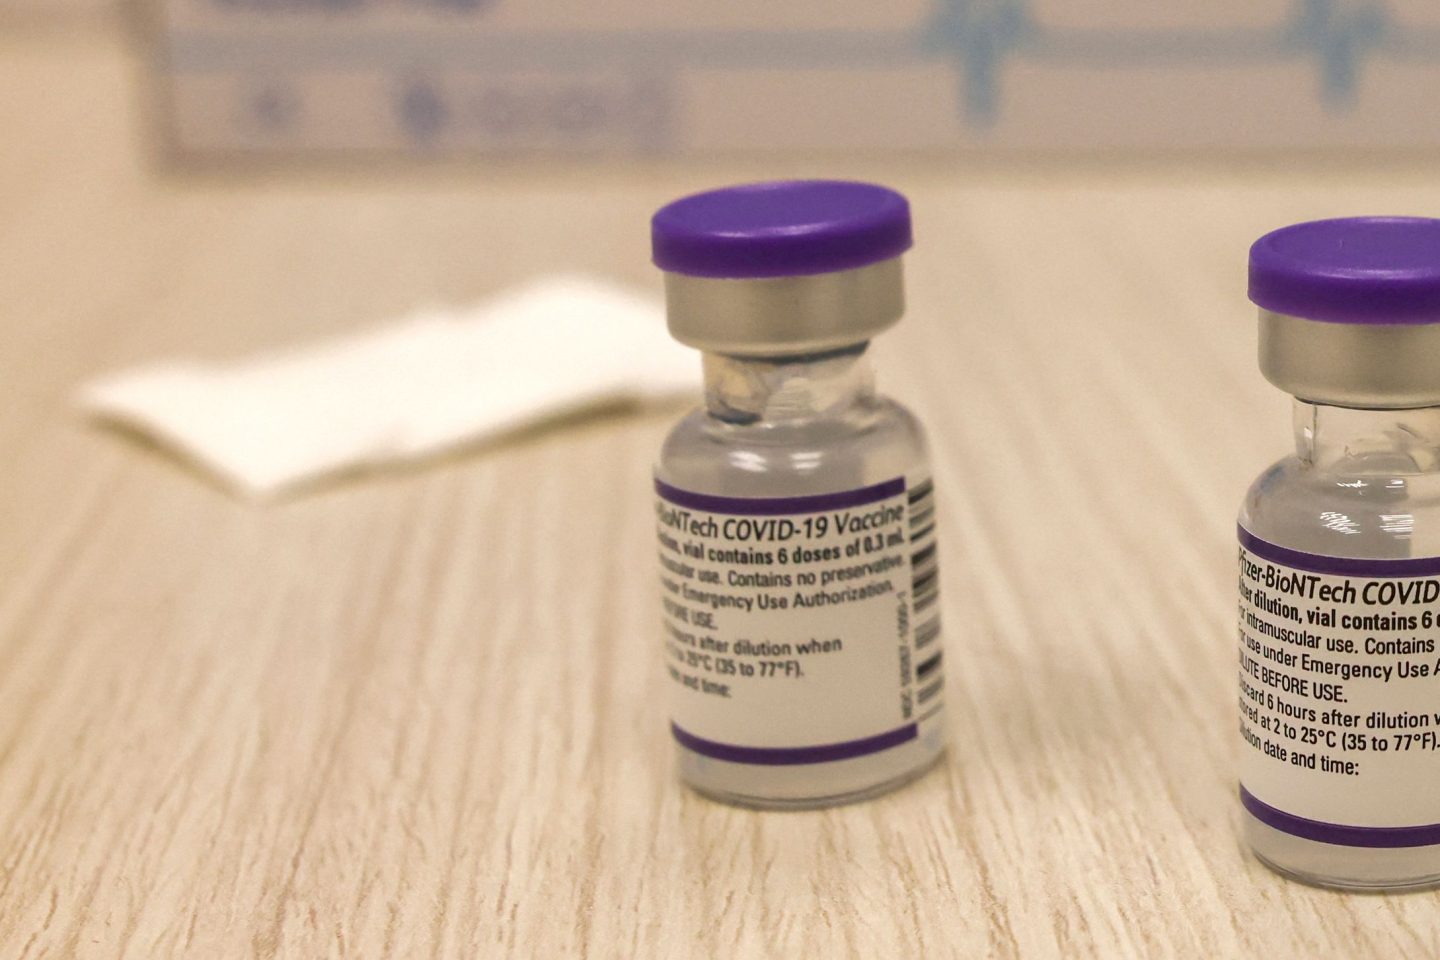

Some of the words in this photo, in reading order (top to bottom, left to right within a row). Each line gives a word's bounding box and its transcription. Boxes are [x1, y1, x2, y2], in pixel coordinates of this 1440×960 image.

[655, 501, 719, 539] oNTech
[723, 516, 829, 542] COVID-19
[834, 504, 905, 536] Vaccine
[708, 547, 774, 565] contains
[777, 547, 789, 565] 6
[792, 545, 842, 565] doses
[845, 538, 860, 558] of
[727, 569, 793, 588] Contains
[797, 572, 817, 586] no
[757, 593, 788, 611] Use
[1254, 588, 1303, 625] dilution,
[1306, 606, 1337, 629] vial
[1341, 610, 1418, 632] contains
[1421, 610, 1433, 630] 6
[733, 638, 791, 657] dilution
[796, 638, 843, 656] when
[1246, 607, 1322, 650] intramuscular
[1326, 637, 1359, 655] use.
[1364, 636, 1435, 656] Contains
[739, 662, 755, 677] to
[1247, 634, 1261, 655] use
[1263, 644, 1299, 668] under
[1301, 653, 1394, 683] Emergency
[1397, 660, 1430, 679] Use
[1261, 666, 1310, 698] BEFORE
[1313, 681, 1349, 704] USE.
[1267, 693, 1275, 712] 6
[1276, 696, 1317, 723] hours
[1321, 708, 1361, 728] after
[1365, 711, 1430, 730] dilution
[1239, 716, 1262, 752] lution
[1263, 738, 1288, 762] date
[1290, 750, 1317, 771] and
[1320, 754, 1360, 777] time:
[1260, 715, 1272, 732] at
[1273, 717, 1281, 736] 2
[1283, 722, 1298, 741] to
[1300, 726, 1337, 749] 25°C
[1341, 731, 1368, 752] (35
[1371, 735, 1389, 752] to
